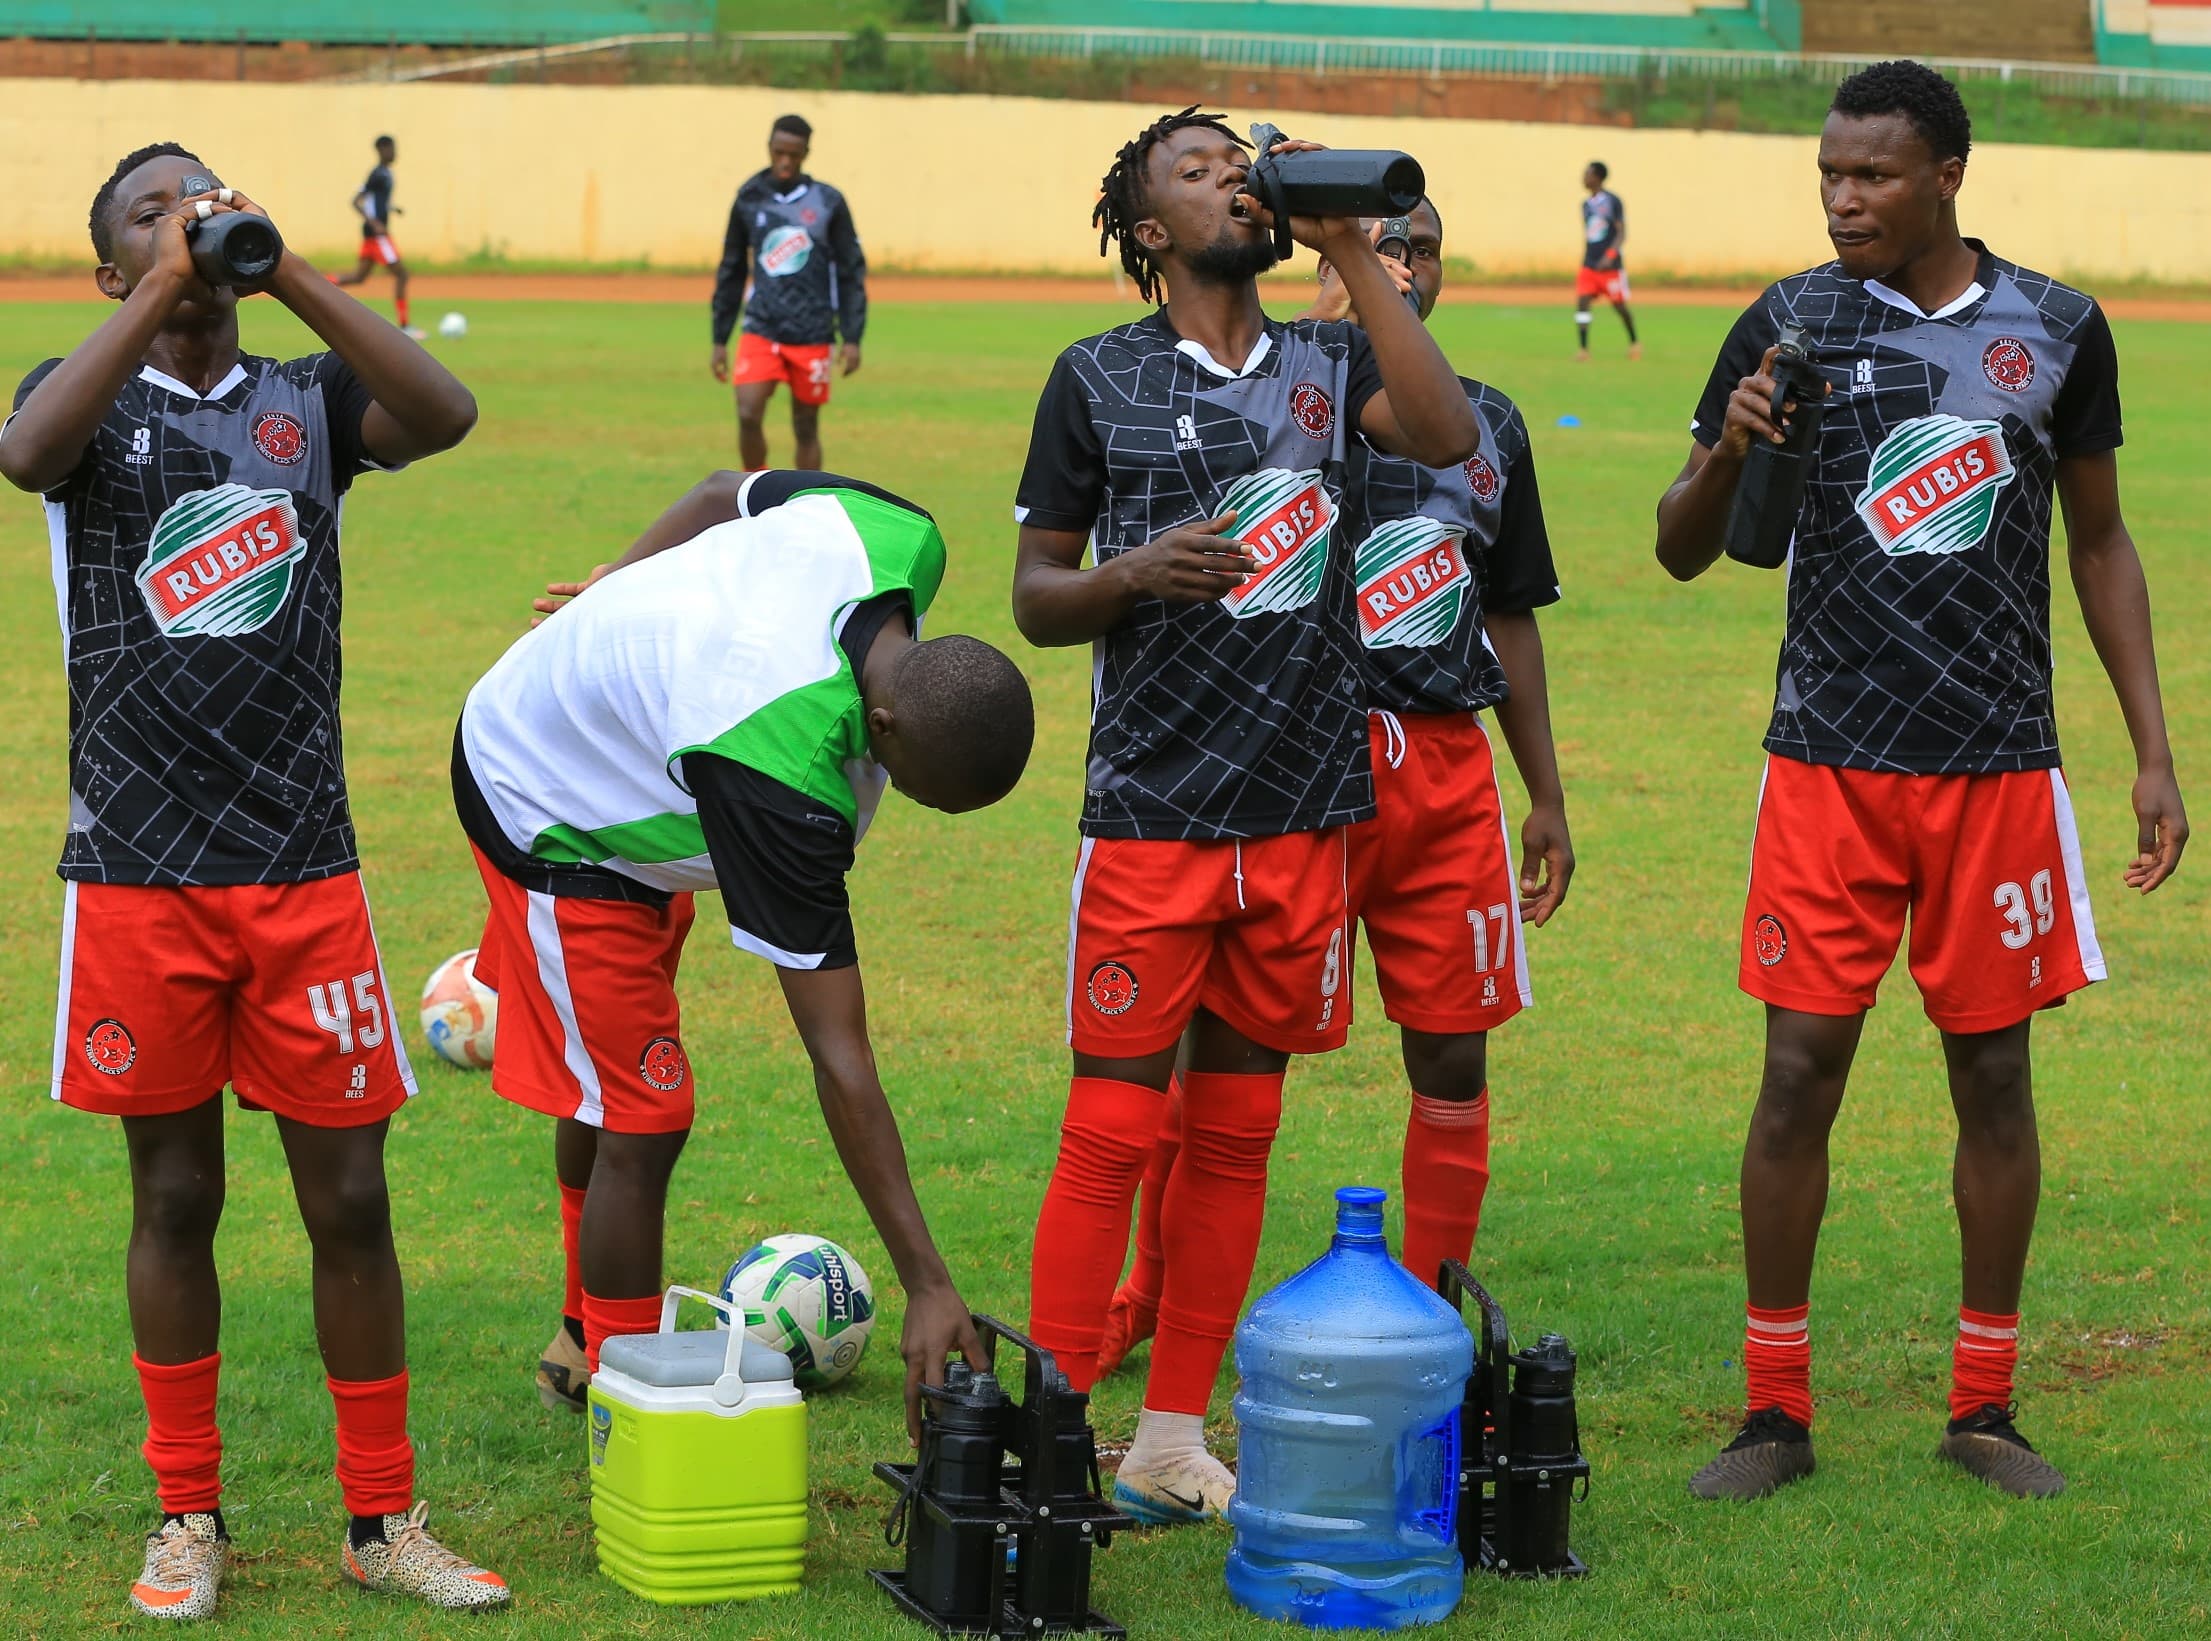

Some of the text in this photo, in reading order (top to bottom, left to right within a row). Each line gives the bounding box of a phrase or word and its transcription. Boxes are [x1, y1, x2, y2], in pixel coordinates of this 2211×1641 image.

[1852, 383, 1876, 394] BEEST
[125, 453, 154, 465] BEEST
[1176, 439, 1208, 451] BEEST
[1245, 499, 1315, 584] UBiS
[1466, 902, 1508, 973] 17
[1993, 868, 2054, 950] 39
[307, 969, 385, 1054] 45
[818, 1246, 848, 1321] uhlsport
